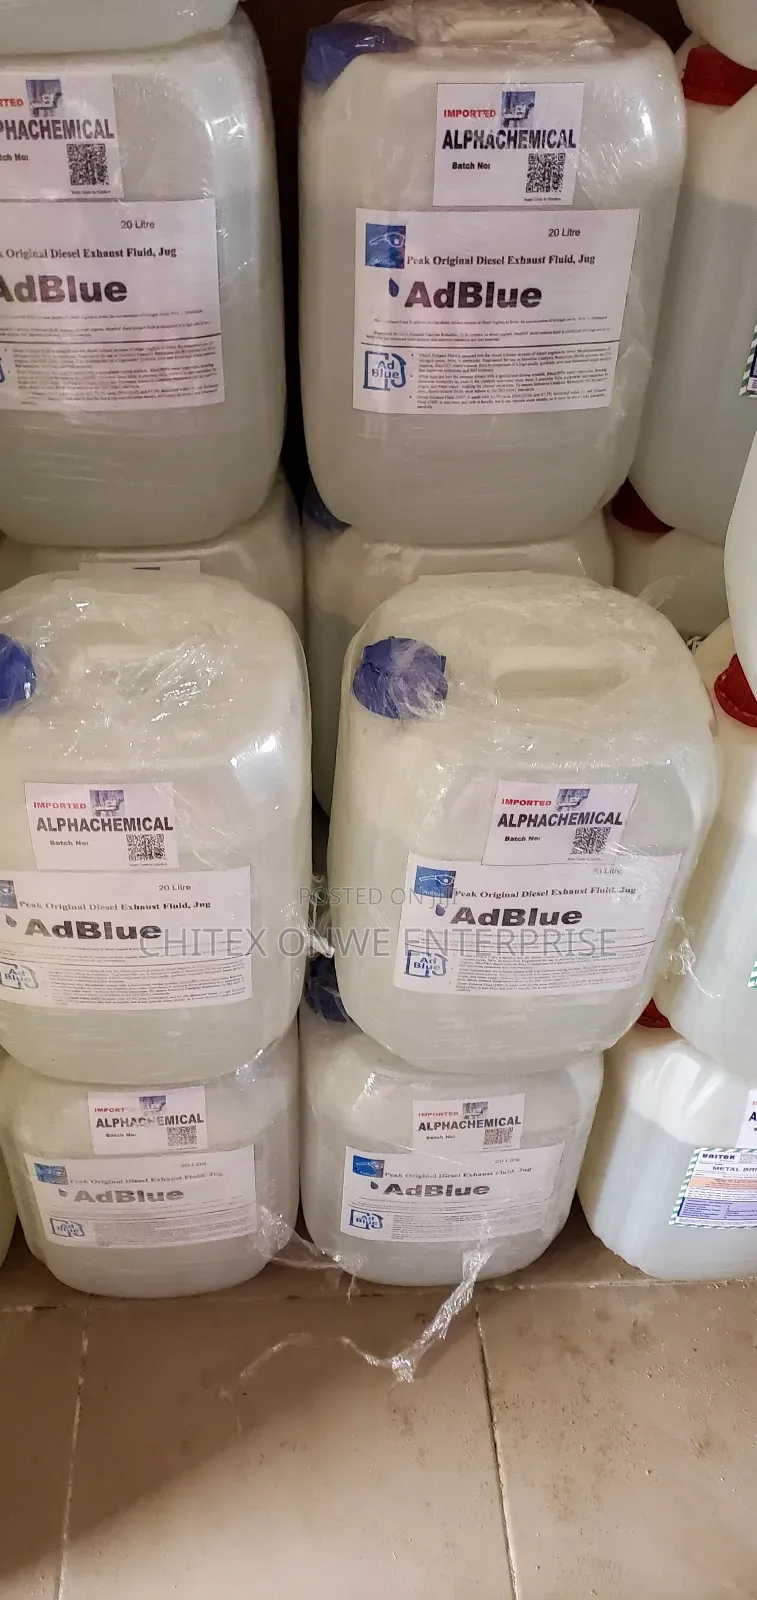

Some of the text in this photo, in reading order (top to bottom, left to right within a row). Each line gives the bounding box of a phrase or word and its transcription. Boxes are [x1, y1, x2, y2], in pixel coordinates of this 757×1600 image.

[443, 109, 497, 118] IMPORTED
[442, 129, 577, 149] ALPHACHEMICAL
[14, 153, 29, 161] No:
[452, 162, 490, 170] Batch No:
[121, 219, 155, 229] 20 Litre
[548, 228, 581, 237] 20 Litre
[5, 248, 47, 260] Original
[51, 248, 80, 259] Diesel
[83, 248, 124, 259] Exhaust
[126, 247, 156, 259] Fluid,
[158, 247, 177, 260] Jug
[407, 255, 431, 265] Peak
[432, 255, 473, 267] Original
[476, 255, 505, 266] Diesel
[507, 255, 545, 265] Exhaust
[548, 254, 576, 266] Fluid,
[578, 254, 596, 265] Jug
[404, 281, 543, 309] AdBlue
[377, 360, 395, 370] Ad
[371, 368, 400, 379] Blue
[33, 801, 87, 810] IMPORTED
[501, 798, 552, 806] IMPORTED
[36, 817, 174, 832] ALPHACHEMICAL
[497, 812, 623, 828] ALPHACHEMICAL
[158, 884, 191, 892] 20 Litre
[455, 890, 478, 898] Peak
[480, 890, 519, 899] Original
[521, 889, 549, 898] Diesel
[550, 887, 588, 896] Exhaust
[19, 900, 211, 911] Peak Original Diesel Exhaust Fluid, Jug
[450, 907, 583, 927] AdBlue
[24, 918, 163, 940] AdBlue
[413, 961, 440, 970] Blue
[96, 1113, 204, 1128] ALPHACHEMICAL
[418, 1115, 522, 1132] ALPHACHEMICAL
[383, 1183, 491, 1198] AdBlue
[73, 1190, 184, 1204] AdBlue
